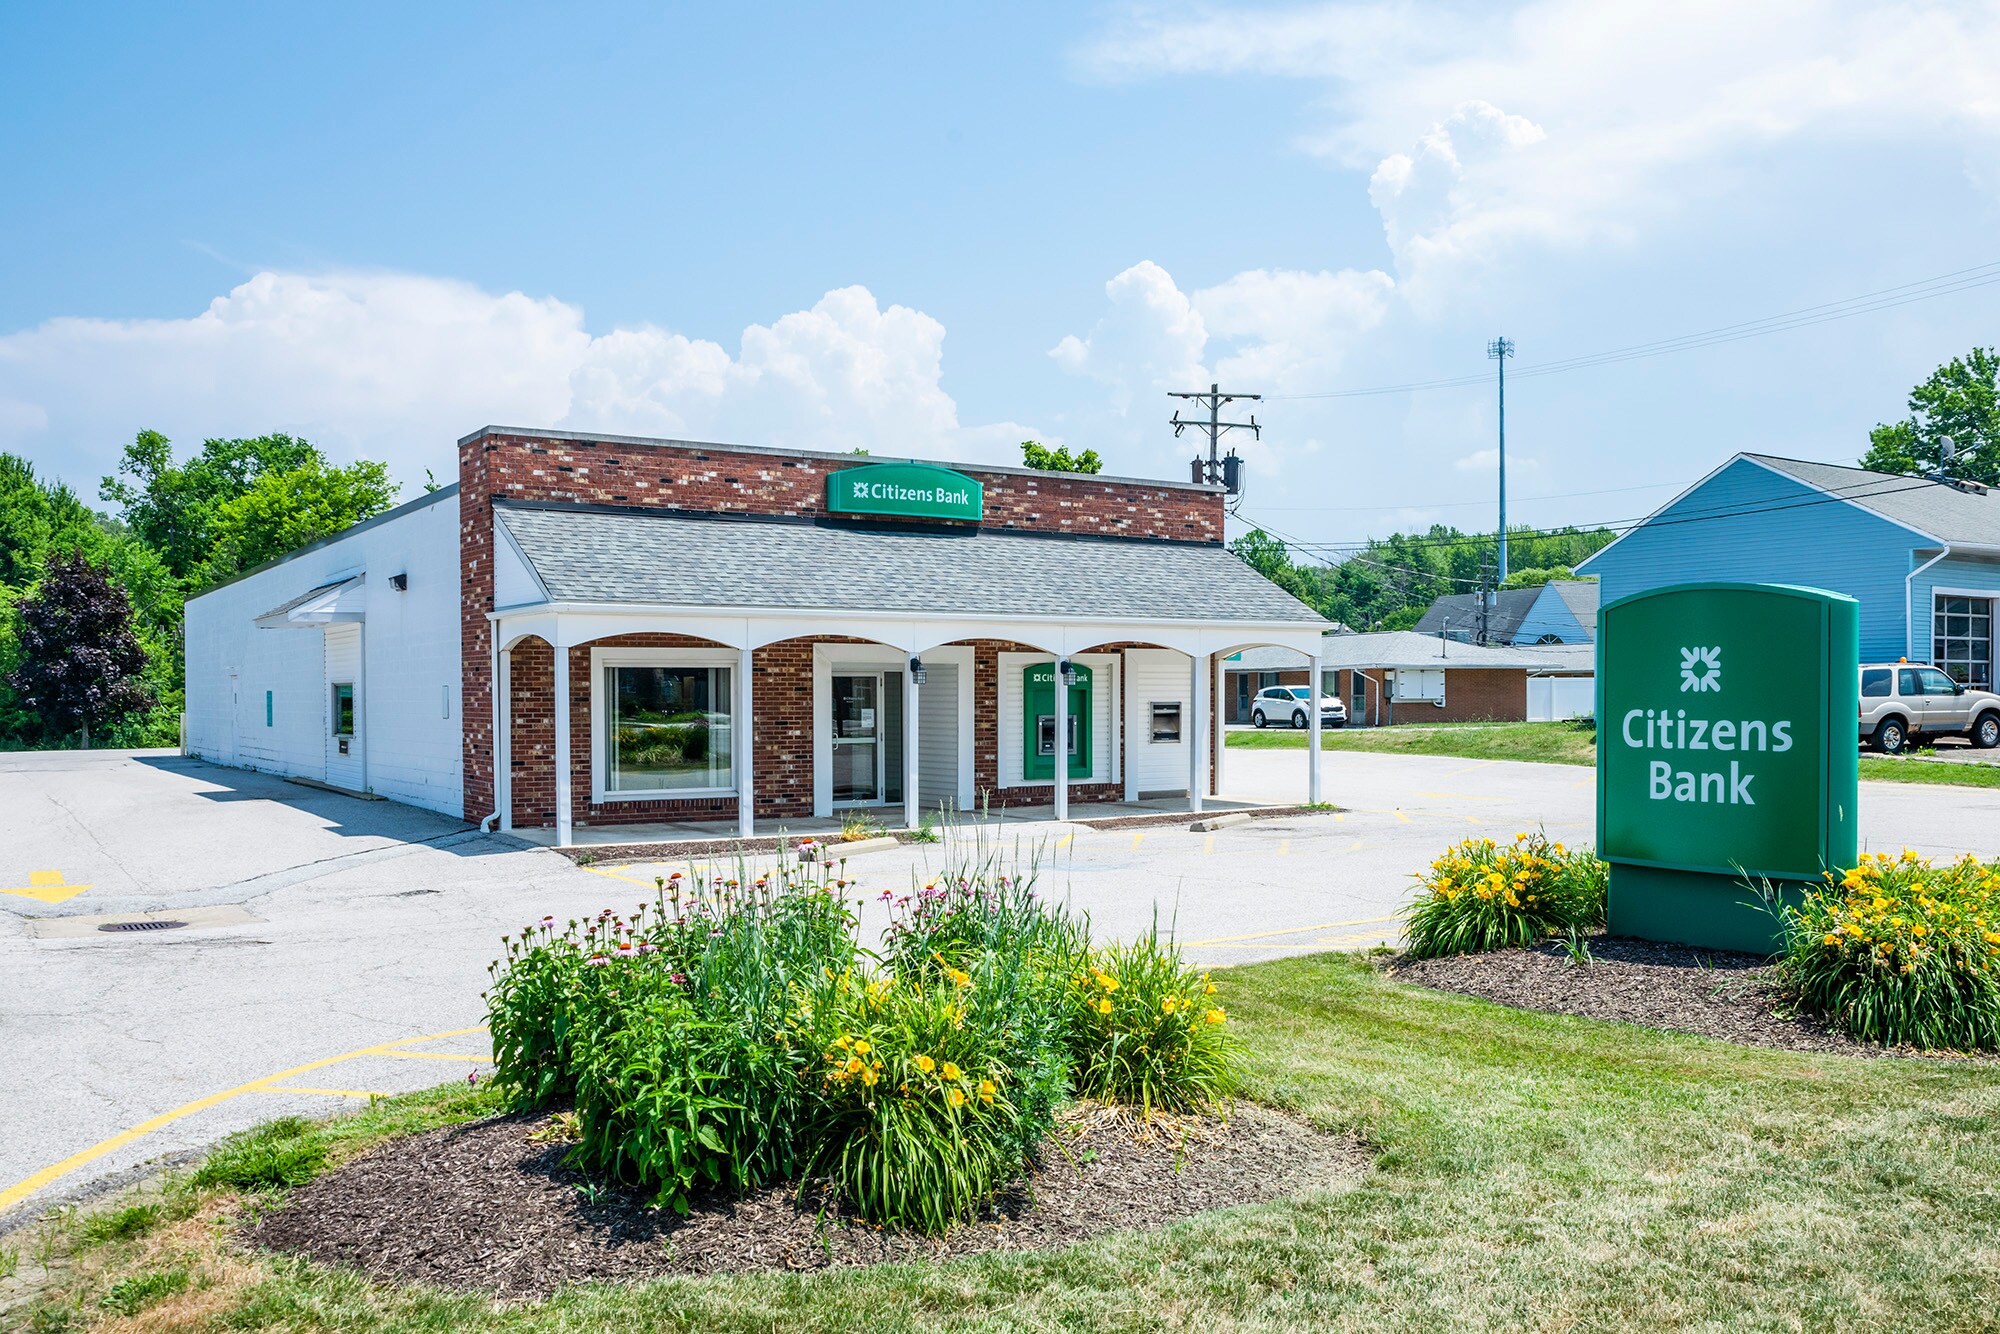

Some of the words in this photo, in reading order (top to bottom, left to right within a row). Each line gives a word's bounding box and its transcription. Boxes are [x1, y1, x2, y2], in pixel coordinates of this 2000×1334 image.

[871, 483, 933, 502] Citizens
[936, 487, 969, 505] Bank
[1622, 708, 1793, 753] Citizens
[1649, 760, 1756, 805] Bank
